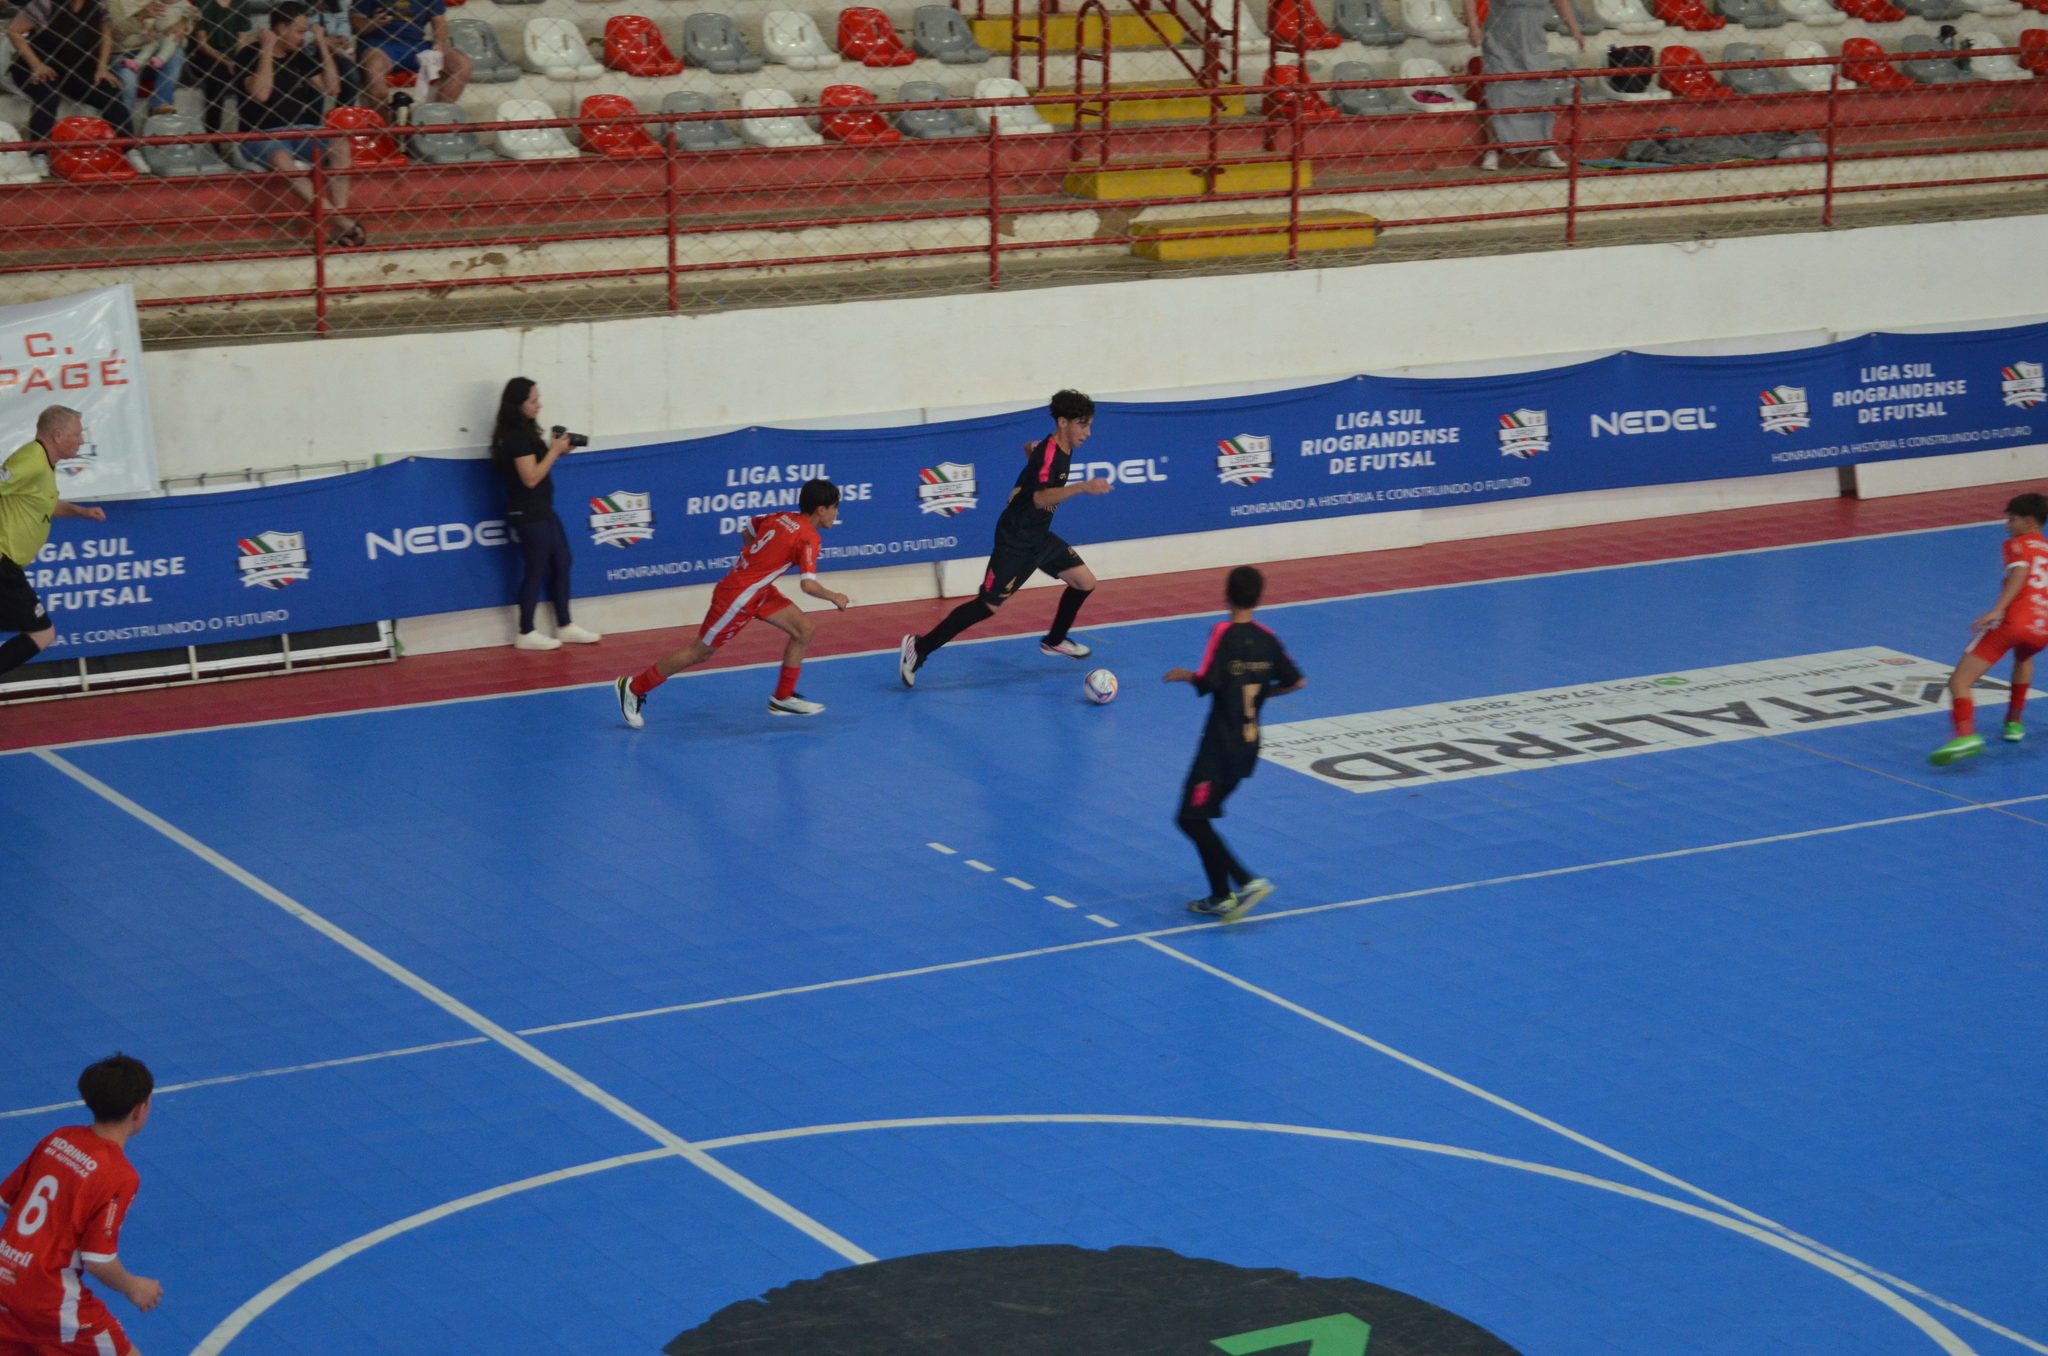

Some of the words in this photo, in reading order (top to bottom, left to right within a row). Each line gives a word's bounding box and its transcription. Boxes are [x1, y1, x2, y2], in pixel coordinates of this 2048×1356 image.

[1860, 365, 1901, 383] LIGA
[1904, 363, 1936, 379] SUL
[1832, 380, 1968, 407] RIOGRANDENSE
[1335, 411, 1382, 431] LIGA
[1386, 409, 1426, 426] SUL
[1858, 407, 1881, 424] DE
[1884, 401, 1948, 421] FUTSAL
[1300, 427, 1460, 457] RIOGRANDENSE
[727, 466, 781, 487] LIGA
[785, 463, 830, 482] SUL
[1065, 458, 1168, 486] EDEL
[1329, 457, 1356, 475] DE
[1360, 450, 1436, 472] FUTSAL
[686, 483, 873, 515] RIOGRANSE
[1230, 499, 1306, 516] HONRANDO
[1307, 498, 1317, 508] A
[1318, 491, 1374, 507] HISTÓRIA
[1376, 490, 1386, 501] E
[1386, 483, 1472, 500] CONSTRUINDO
[1473, 481, 1484, 492] O
[1485, 476, 1532, 490] FUTURO
[81, 537, 135, 558] SUL
[365, 520, 520, 560] NEDE
[606, 561, 692, 580] HONRANDO
[694, 560, 706, 571] A
[888, 541, 901, 553] O
[903, 536, 958, 551] FUTURO
[47, 585, 152, 611] FUTSAL
[71, 632, 82, 645] E
[83, 618, 206, 643] CONSTRUINDO
[208, 617, 224, 630] O
[225, 609, 289, 627] FUTURO
[17, 1174, 59, 1236] 6
